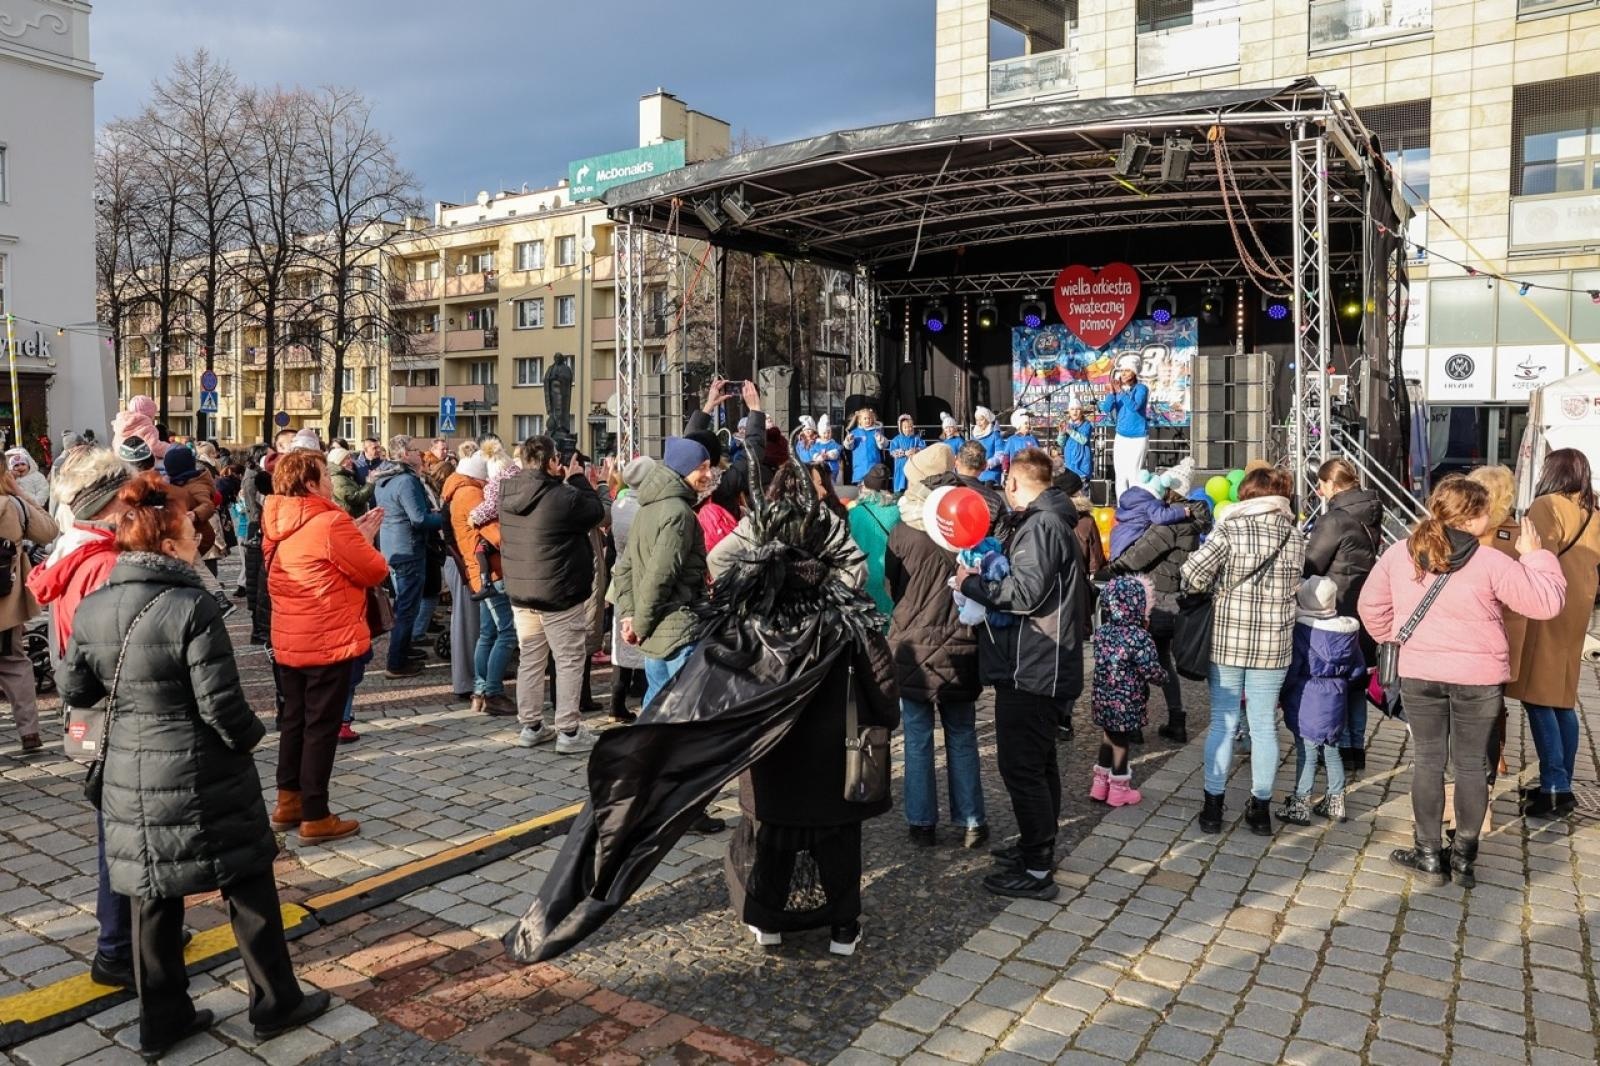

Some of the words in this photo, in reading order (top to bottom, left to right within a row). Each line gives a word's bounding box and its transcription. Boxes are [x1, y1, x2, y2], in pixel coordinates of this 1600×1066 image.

[596, 161, 654, 182] McDonald's
[1061, 277, 1091, 296] wielka
[1092, 277, 1132, 295] orkiestra
[1069, 297, 1125, 320] świątecznej
[1080, 319, 1116, 335] pomocy
